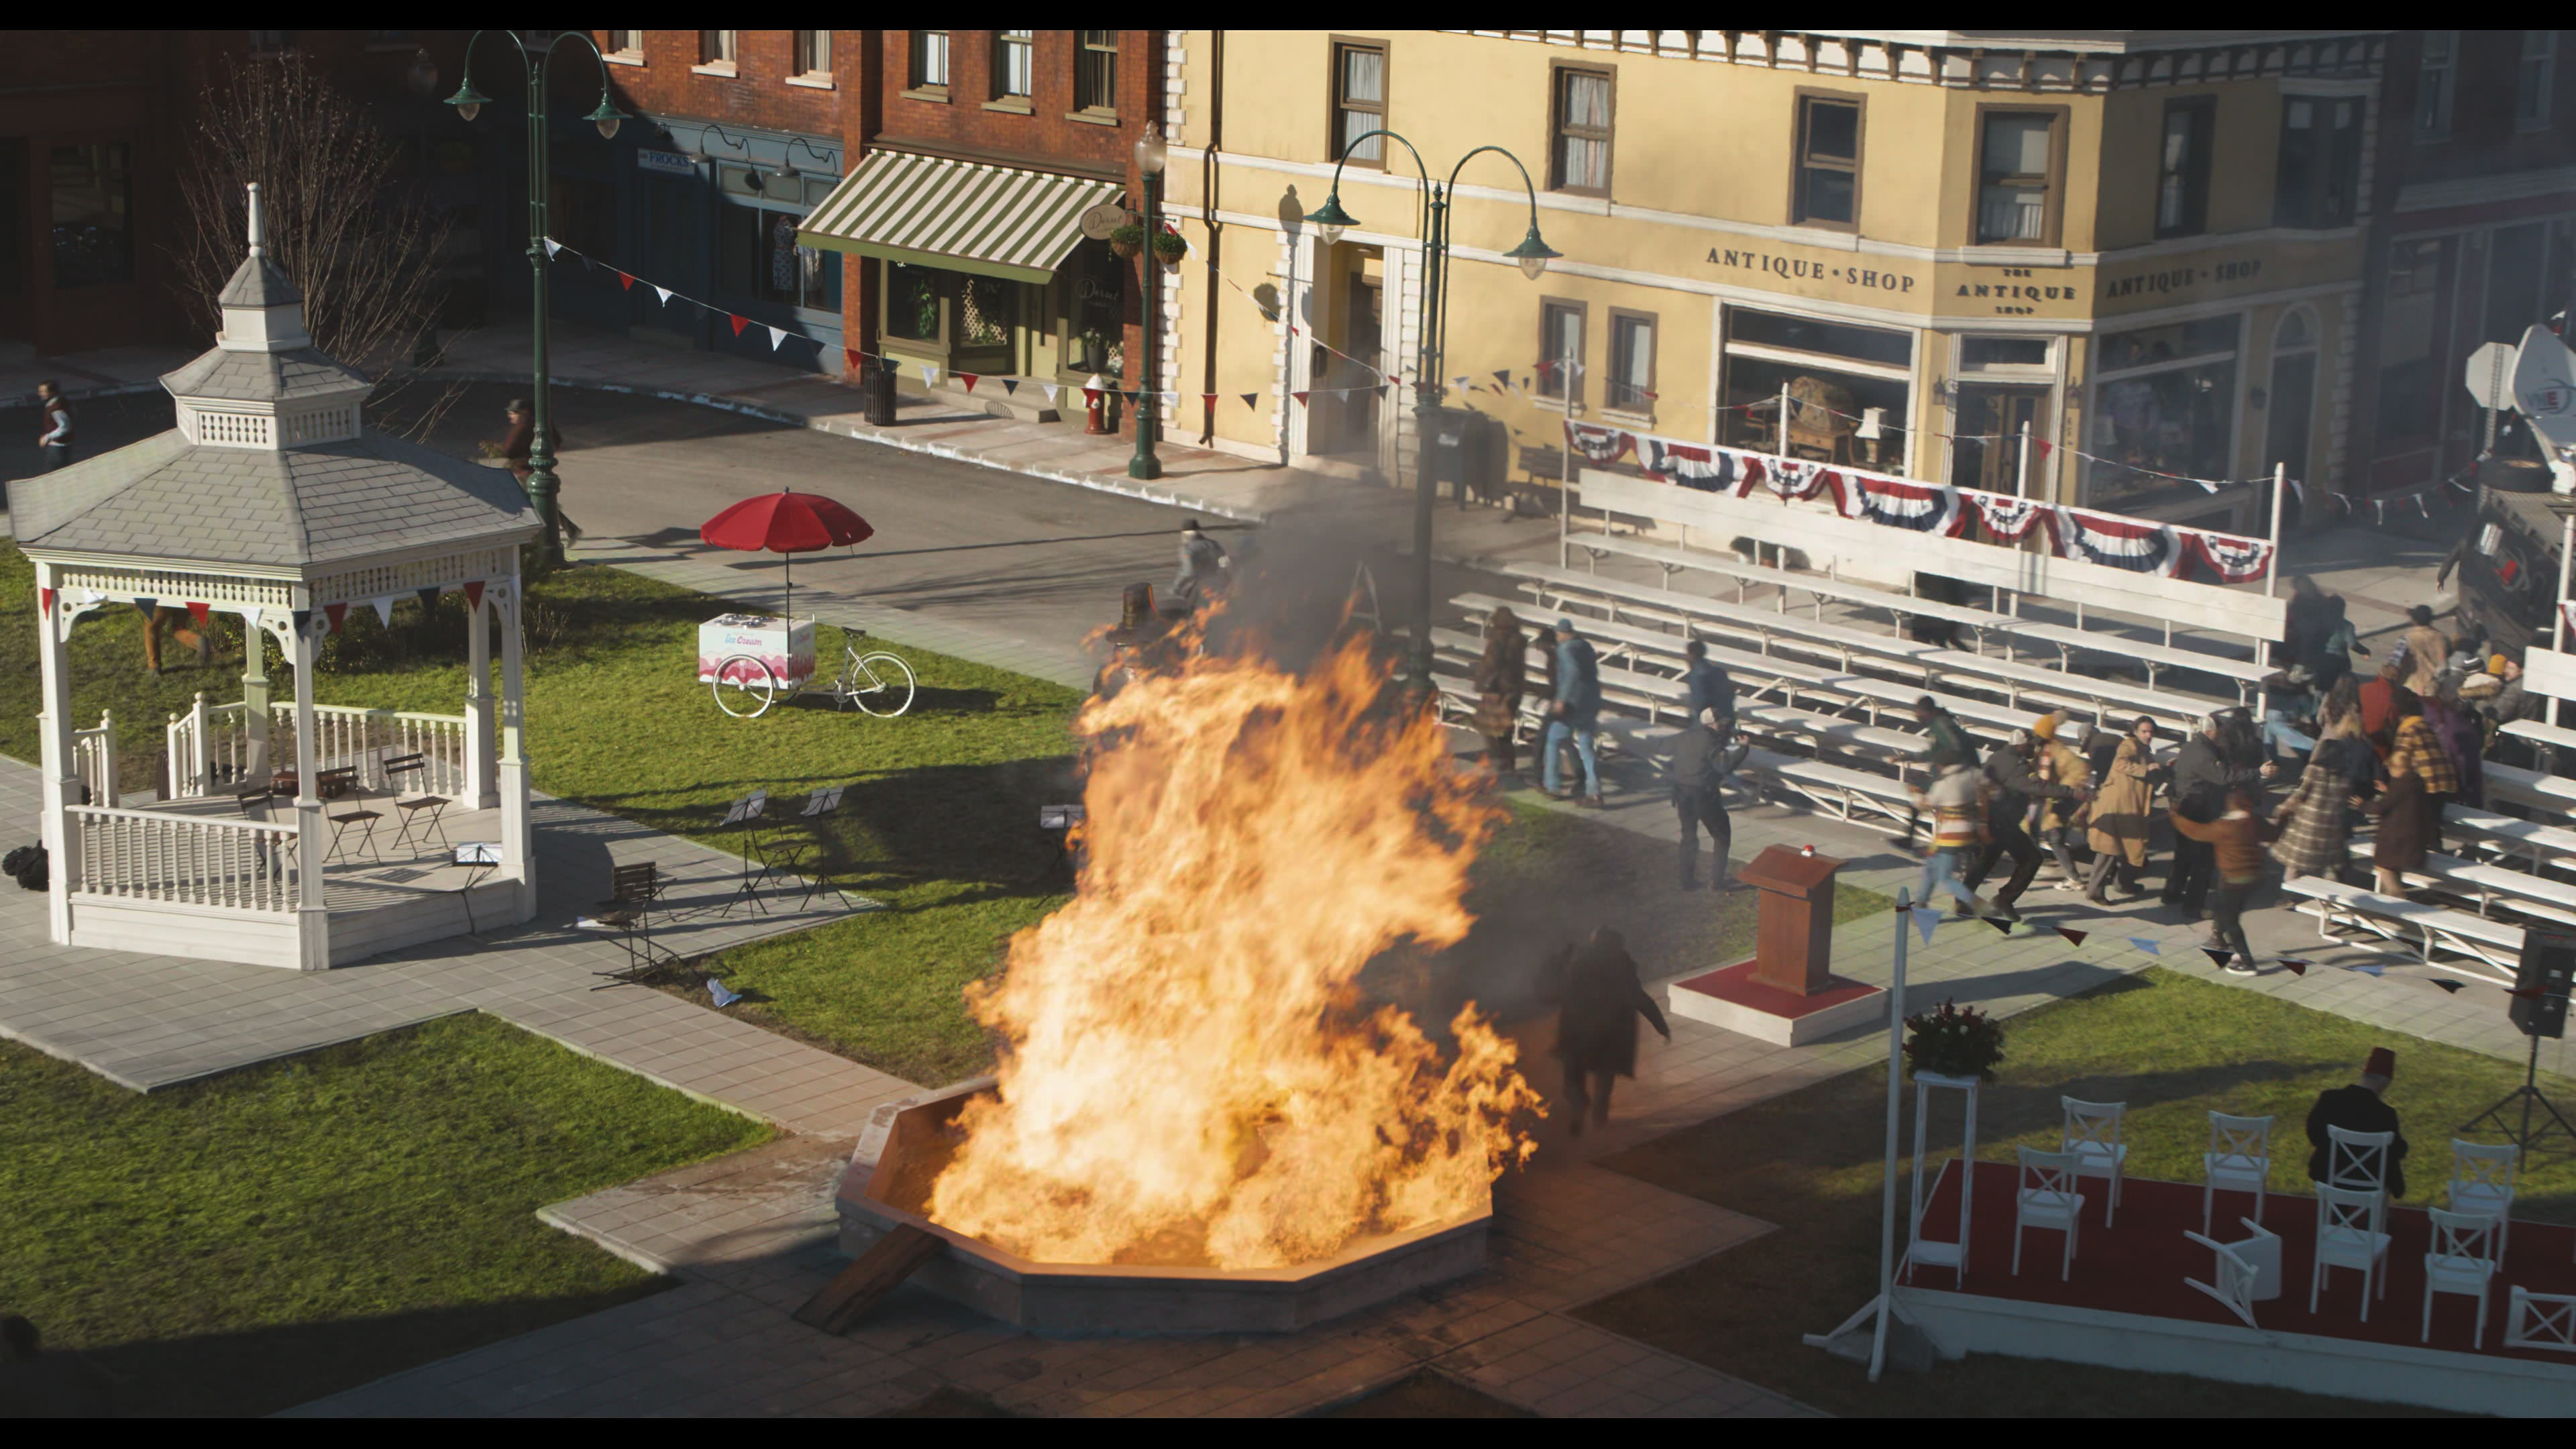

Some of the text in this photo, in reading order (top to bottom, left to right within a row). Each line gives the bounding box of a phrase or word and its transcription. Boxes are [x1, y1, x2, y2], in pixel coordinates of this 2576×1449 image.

[1707, 248, 1915, 292] ANTIQUE SHOP
[2002, 268, 2032, 278] THE
[2106, 260, 2262, 299] ANTIQUE SHOP
[1956, 284, 2076, 303] ANTIQUE
[1995, 306, 2035, 315] SHOP
